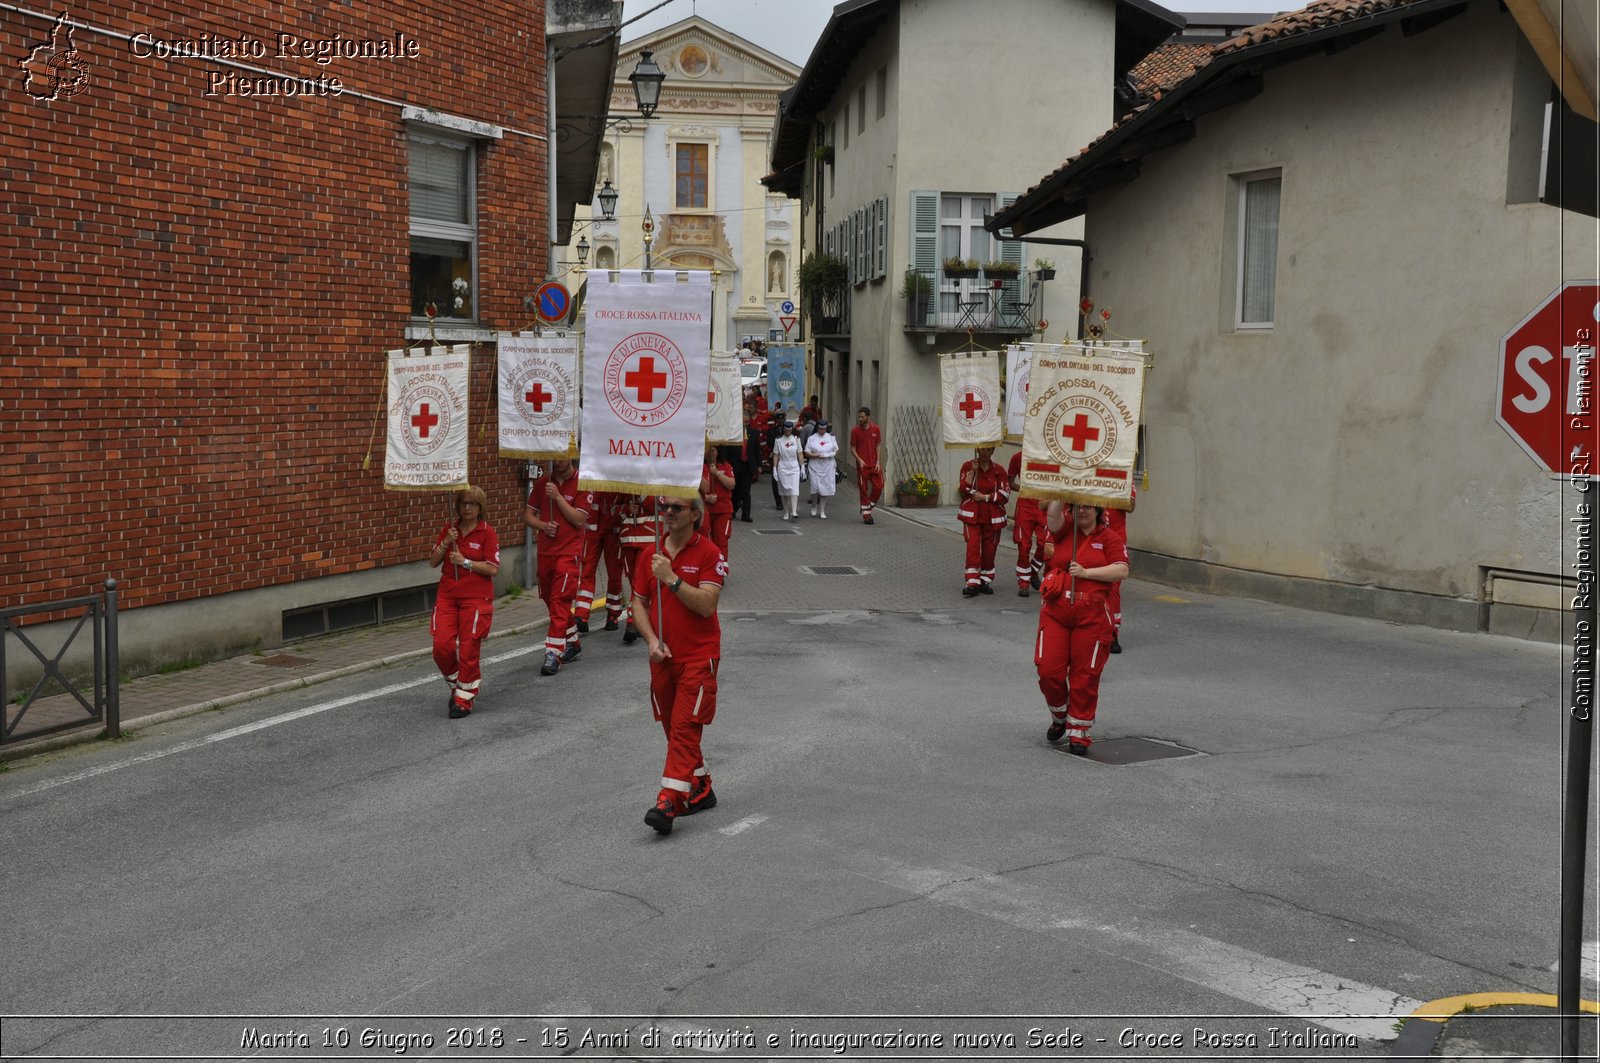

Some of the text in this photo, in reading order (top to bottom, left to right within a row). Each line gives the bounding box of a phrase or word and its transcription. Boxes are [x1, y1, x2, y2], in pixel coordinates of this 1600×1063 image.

[595, 310, 702, 321] CROCE ROSSA ITALIANA
[506, 358, 573, 391] CROCE ROSSA ITALIANA
[1039, 359, 1057, 369] CORPO
[1057, 361, 1090, 371] VOLONTARI
[1092, 363, 1104, 372] DEL
[1107, 365, 1136, 375] SOCCORSO
[606, 336, 684, 423] CONVENZIONE DI GINEVRA 22 AGOSTO 1864
[407, 373, 436, 387] ROSSA
[437, 375, 464, 411] ITALIANA
[416, 388, 442, 400] GINEVRA
[1029, 387, 1057, 417] CROCE
[1058, 378, 1096, 391] ROSSA
[1098, 384, 1134, 428] ITALIANA
[1058, 402, 1069, 412] DI
[1070, 398, 1105, 415] GINEVRA
[1104, 414, 1113, 425] 22
[502, 428, 531, 437] GRUPPO
[532, 429, 539, 437] DI
[1046, 411, 1071, 464] CONVENZIONE
[608, 439, 676, 458] MANTA
[1101, 427, 1116, 456] AGOSTO
[388, 460, 464, 472] GRUPPO DI MELLE
[387, 472, 462, 483] COMITATO LOCALE
[1025, 472, 1070, 484] COMITATO
[1072, 479, 1081, 487] DI
